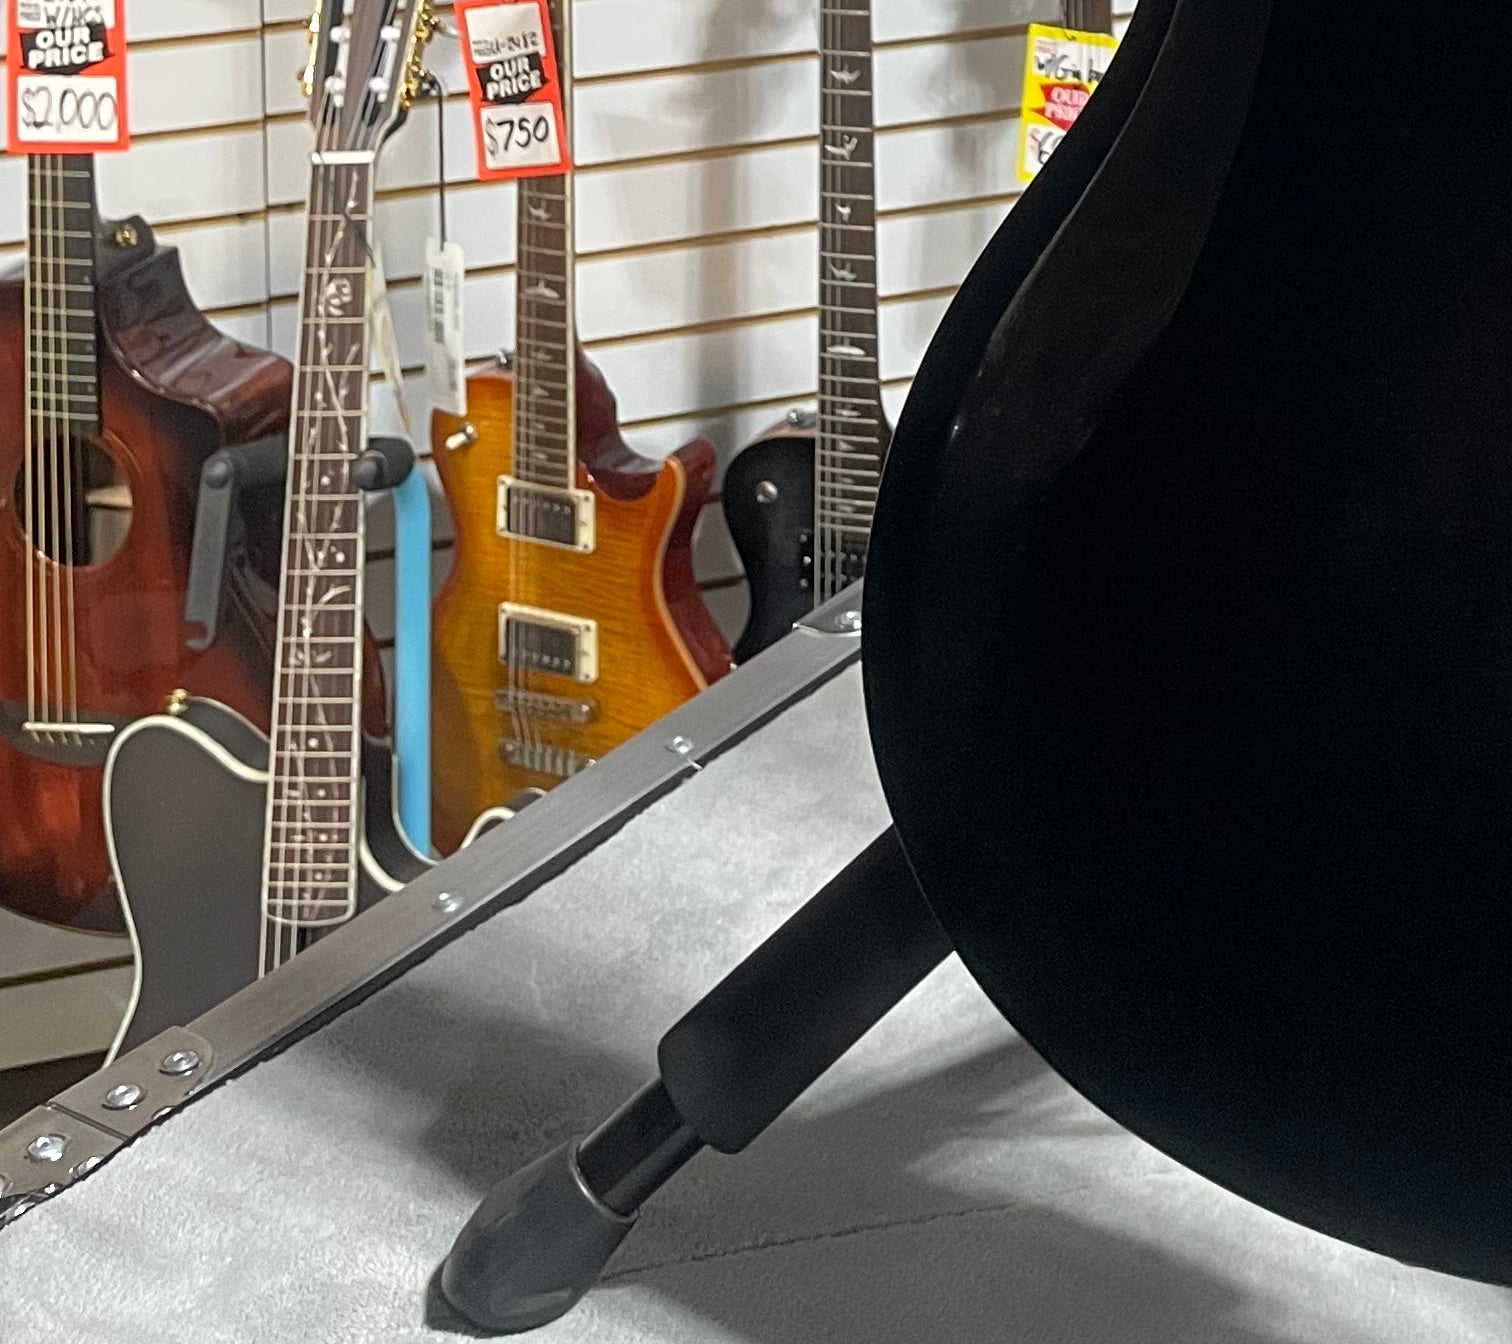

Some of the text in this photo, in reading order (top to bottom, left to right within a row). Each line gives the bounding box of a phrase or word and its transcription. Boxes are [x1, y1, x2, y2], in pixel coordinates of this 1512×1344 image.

[35, 26, 92, 50] OUR
[27, 41, 106, 70] PRICE
[489, 54, 531, 81] OUR
[484, 69, 542, 101] PRICE
[484, 115, 550, 159] $750
